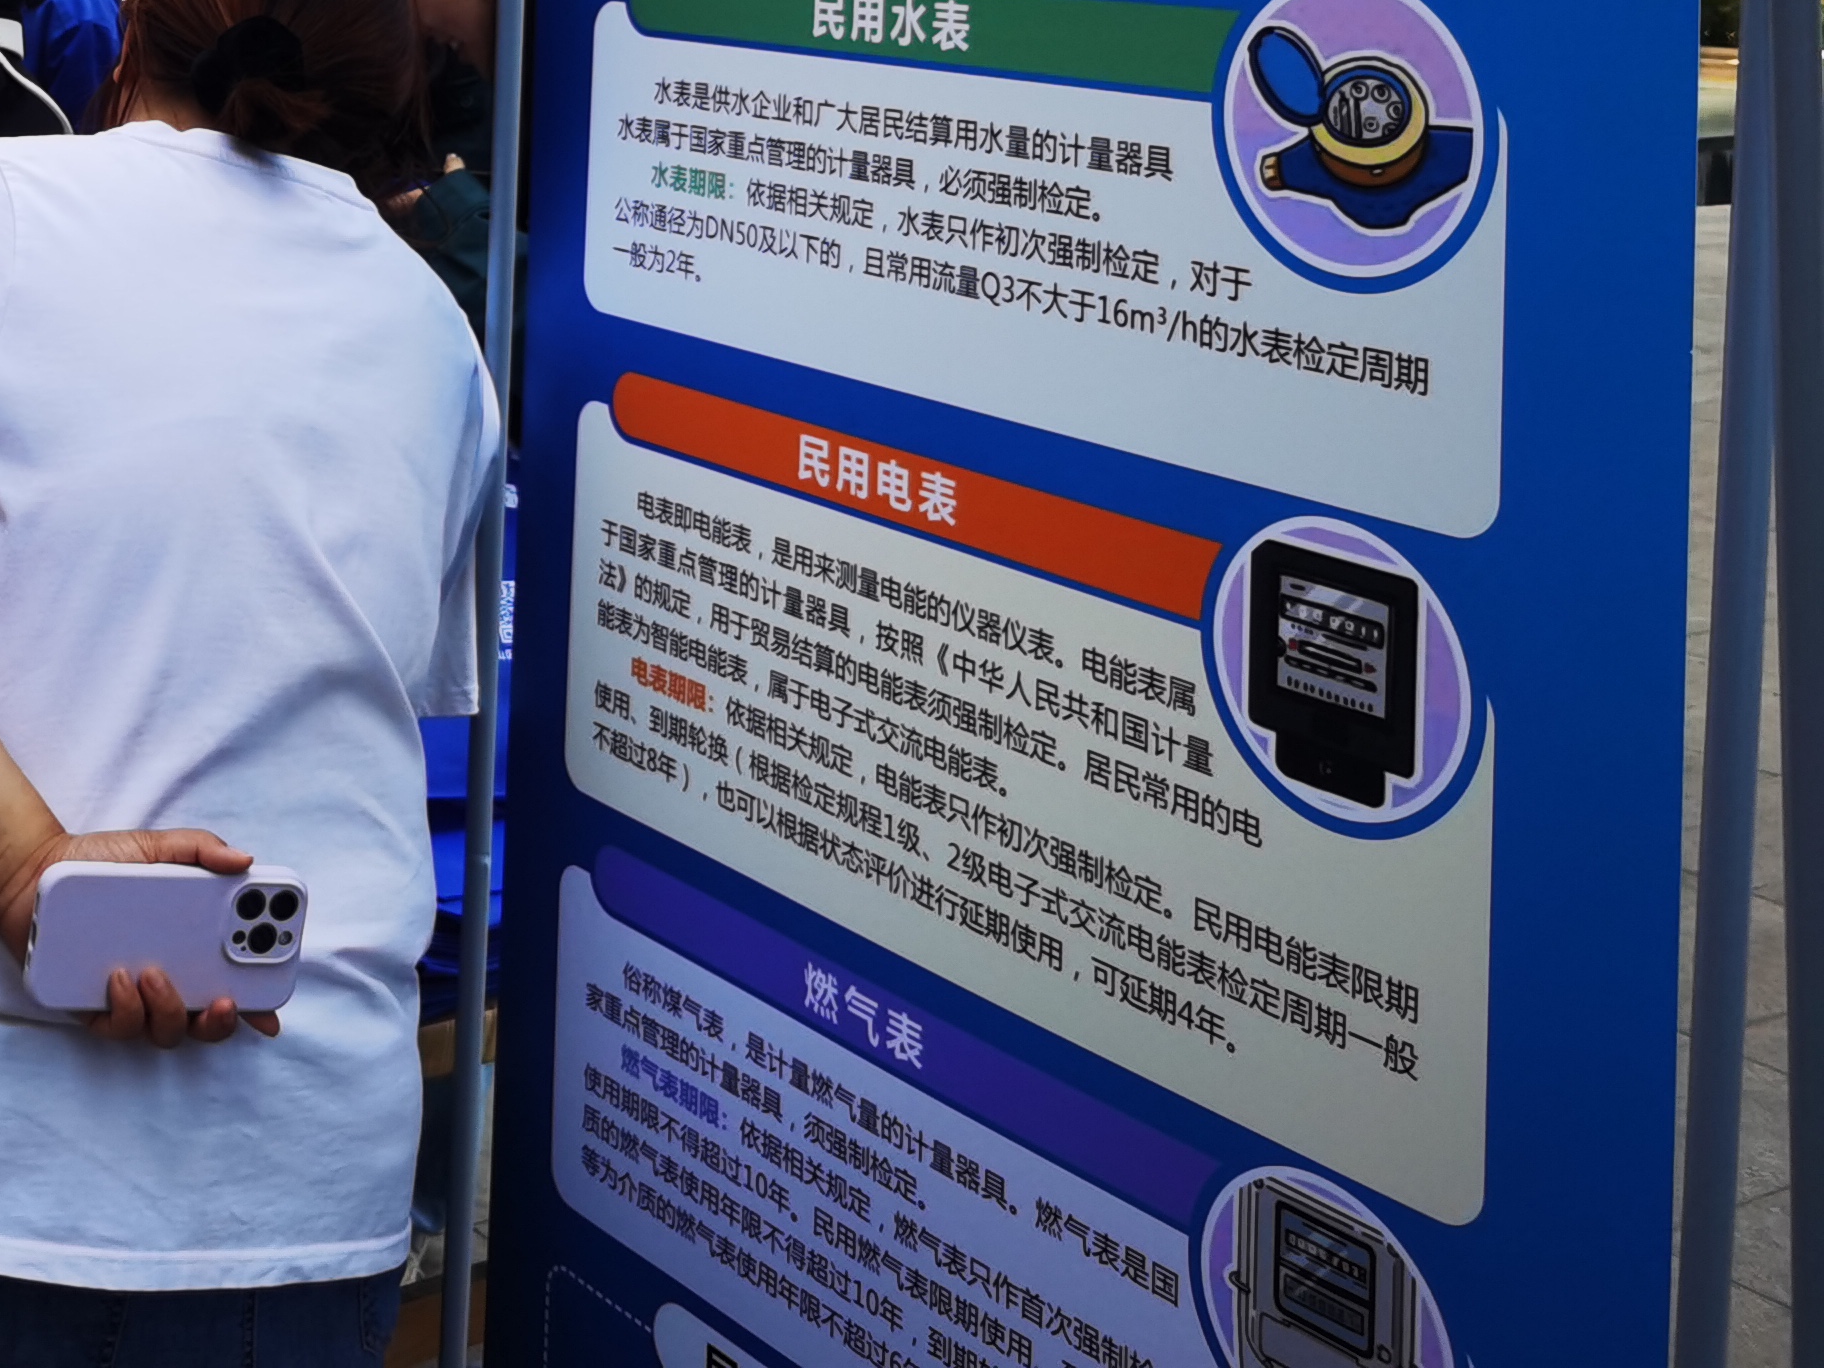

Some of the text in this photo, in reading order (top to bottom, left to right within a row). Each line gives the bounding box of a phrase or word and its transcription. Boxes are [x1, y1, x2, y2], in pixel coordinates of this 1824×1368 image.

[617, 113, 1101, 223] 水表属于国家重点管理的计量器具，必须强制检定。
[651, 160, 1253, 301] 水表期限：依据相关规定，水表只作初次强制检定，对于
[654, 76, 1174, 182] 水表是供水企业和广大居民结算用水量的计量器具
[612, 242, 703, 283] 一般为2年。
[797, 433, 958, 526] 民用电表
[596, 598, 1009, 798] 能表为智能电能表，属于电子式交流电能表。
[598, 558, 1263, 849] 法》的规定，用于贸易结算的电能表须强制检定。居民常用的电
[600, 519, 1215, 778] 于国家重点管理的计量器具，按照《中华人民共和国计量
[636, 491, 1197, 717] 电表即电能表，是用来测量电能的仪器仪表。电能表属
[630, 656, 1419, 1024] 电表期限：依据相关规定，电能表只作初次强制检定。民用电能表限期
[585, 982, 926, 1211] 家重点管理的计量器具，须强制检定。
[804, 961, 924, 1070] 燃气表
[582, 1104, 998, 1368] 质的燃气表使用年限不得超过10年，到期
[622, 960, 1179, 1308] 俗称煤气表，是计量燃气量的计量器具。燃气表是国
[581, 1143, 921, 1368] 等为介质的燃气表使用年限不超过6
